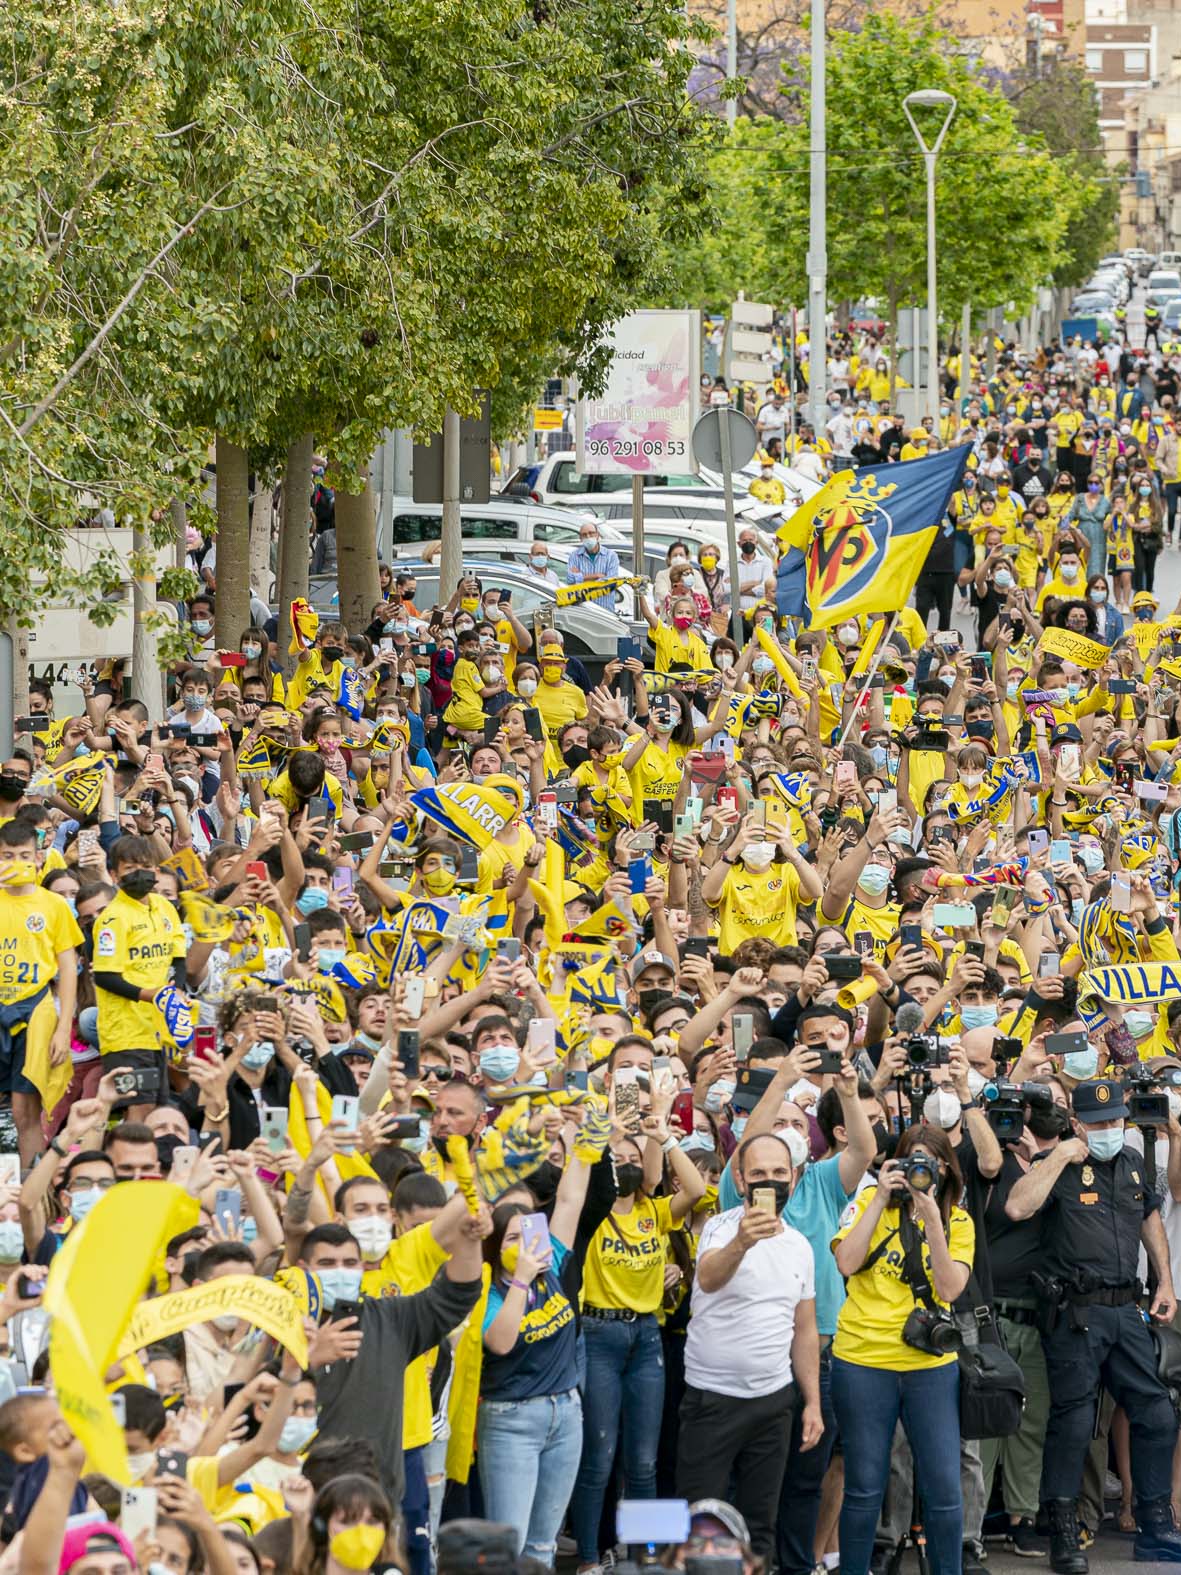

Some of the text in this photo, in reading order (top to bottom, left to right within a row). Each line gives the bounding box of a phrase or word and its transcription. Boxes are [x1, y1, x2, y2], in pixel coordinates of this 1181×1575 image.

[590, 441, 685, 456] 96 291 08 53
[440, 783, 505, 837] LLARR
[17, 961, 38, 984] 21
